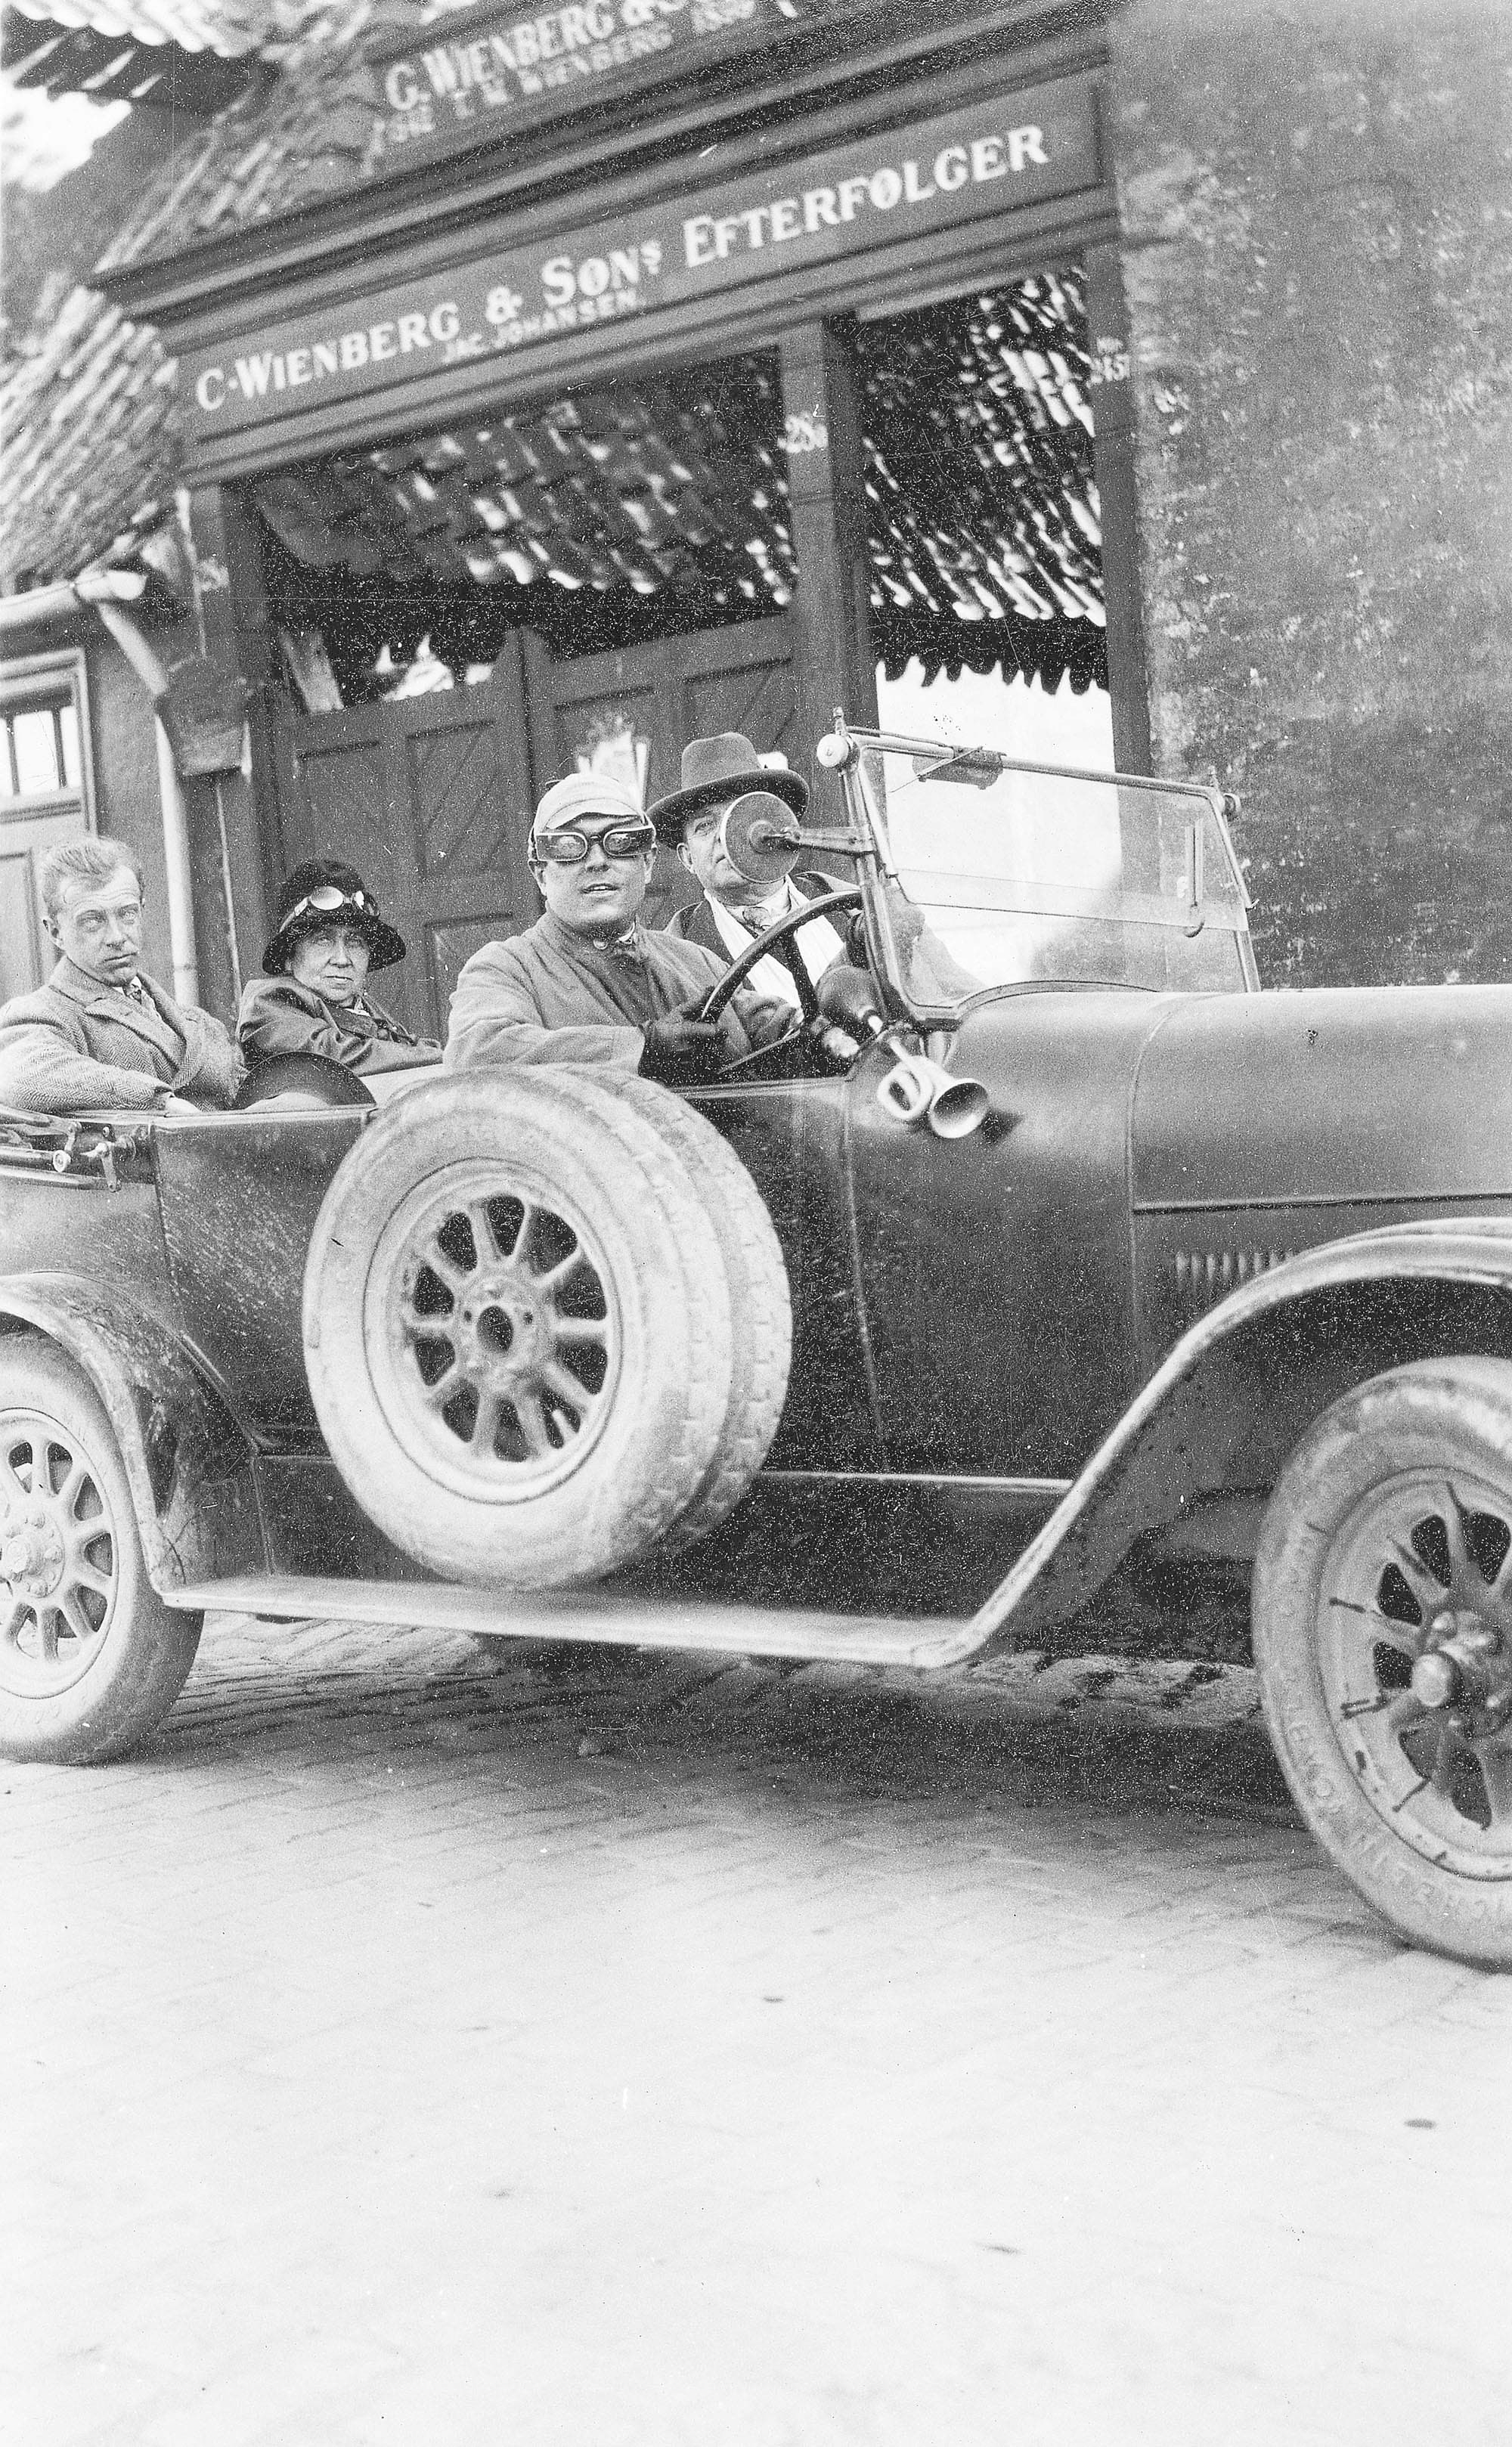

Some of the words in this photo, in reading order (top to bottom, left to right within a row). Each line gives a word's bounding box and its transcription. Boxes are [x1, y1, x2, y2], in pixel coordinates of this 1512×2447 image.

[422, 0, 616, 98] WIENBERG
[234, 301, 460, 399] WIENBERG
[485, 284, 523, 325] &
[683, 124, 1052, 268] EFTERFØLGER
